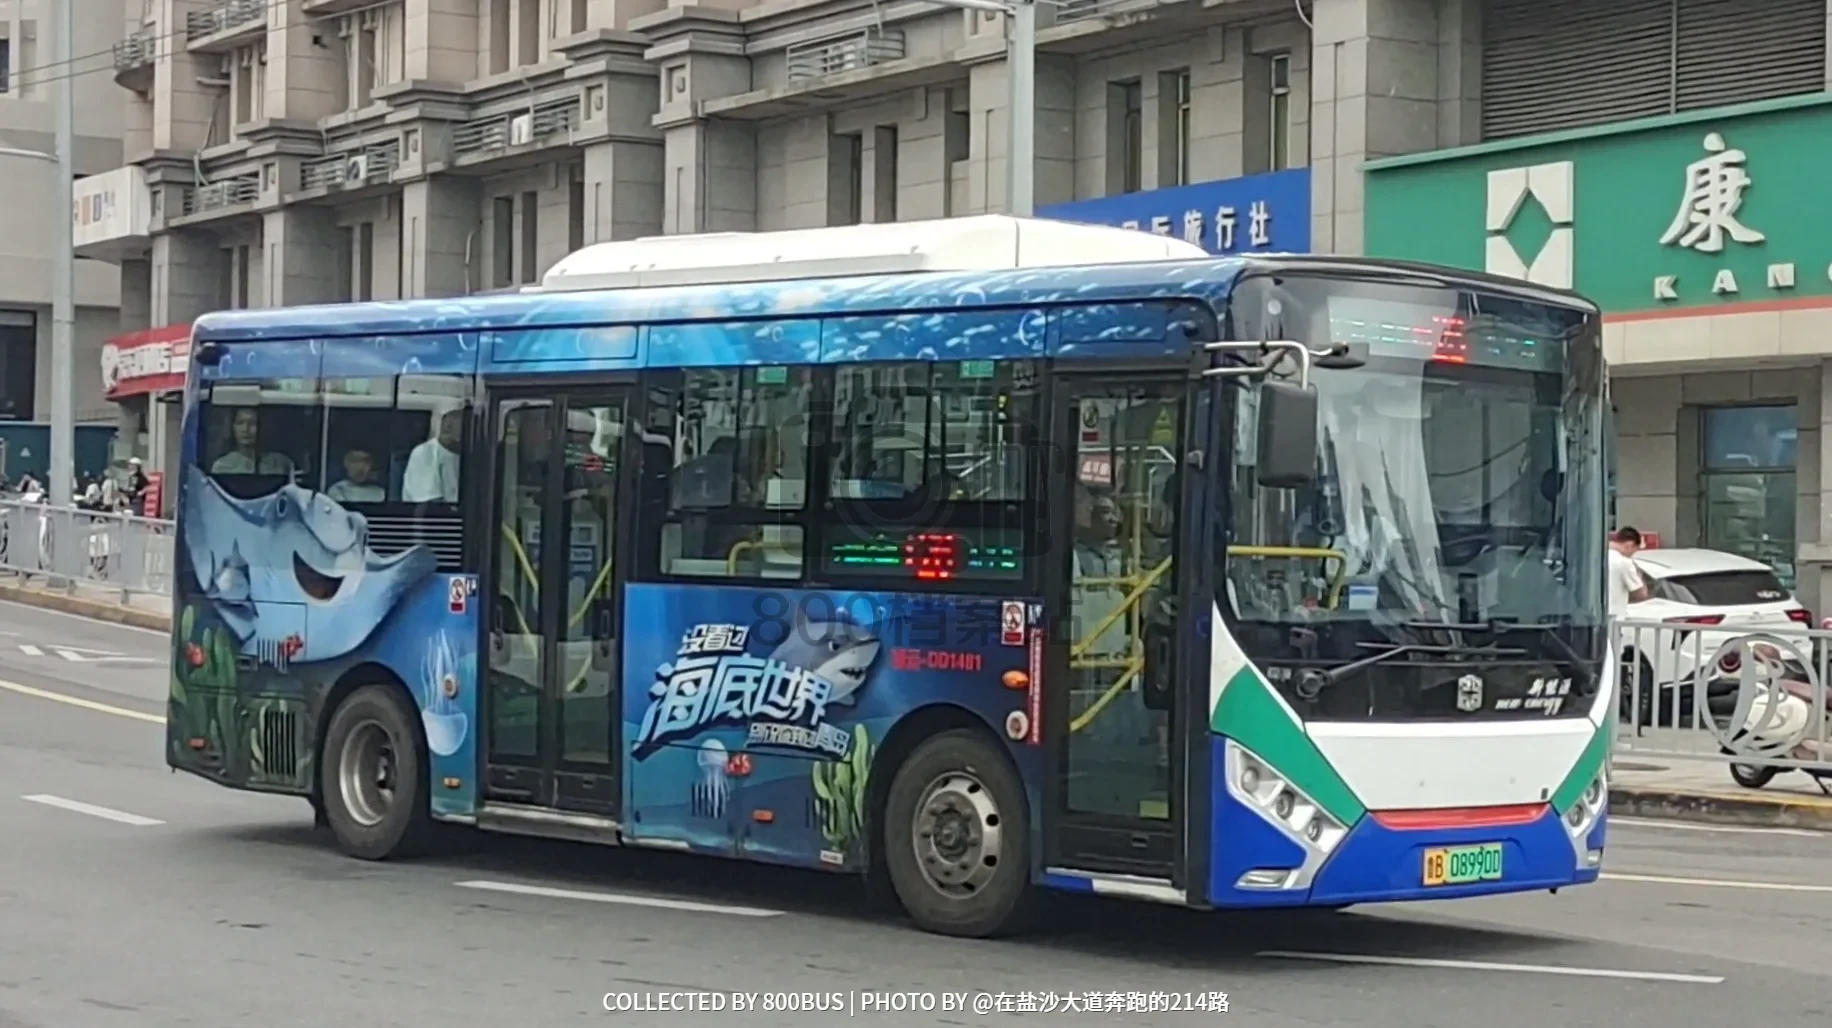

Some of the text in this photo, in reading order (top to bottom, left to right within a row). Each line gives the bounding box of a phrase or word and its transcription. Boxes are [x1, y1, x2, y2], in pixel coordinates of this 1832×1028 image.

[1659, 132, 1766, 252] 康
[1122, 201, 1271, 249] 旅行社
[1654, 263, 1832, 299] KAN
[676, 623, 750, 655] 没看过
[632, 652, 834, 753] 海底世界
